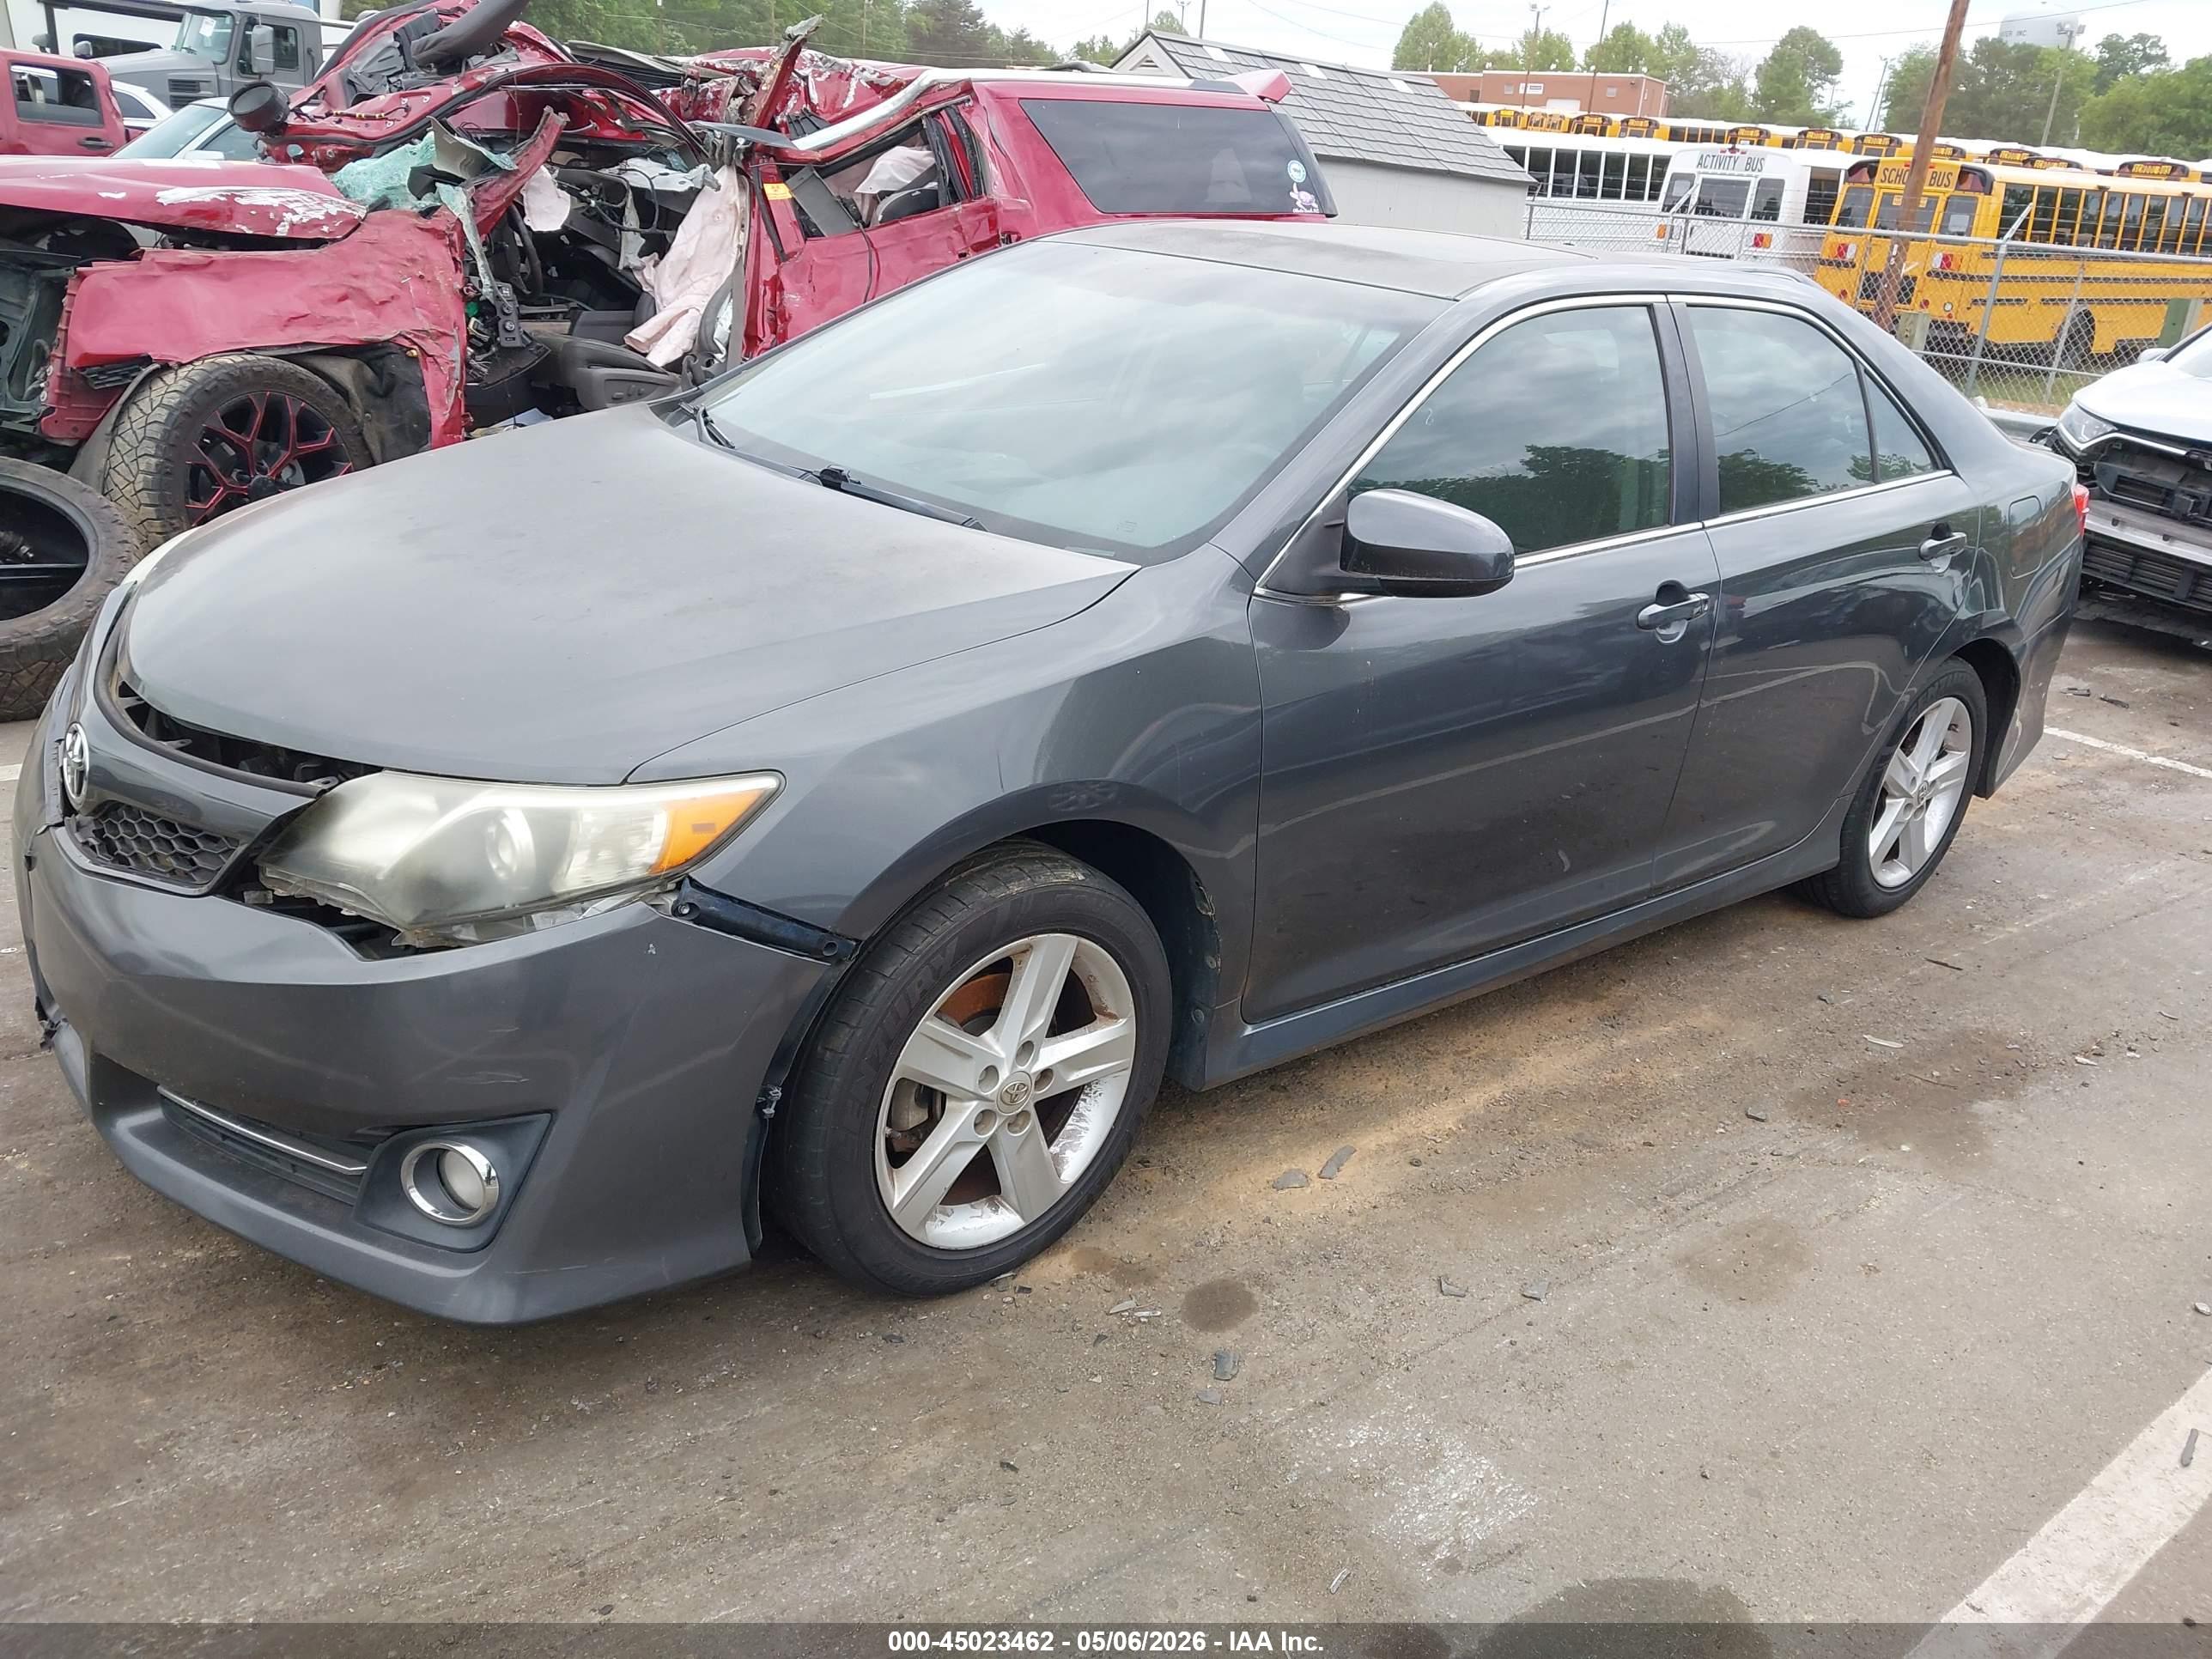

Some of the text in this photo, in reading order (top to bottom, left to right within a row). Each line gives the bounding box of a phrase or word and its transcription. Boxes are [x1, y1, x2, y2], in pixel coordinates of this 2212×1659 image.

[1696, 154, 1765, 173] ACTIVITY BUS
[1881, 167, 1953, 188] SCHO BUS
